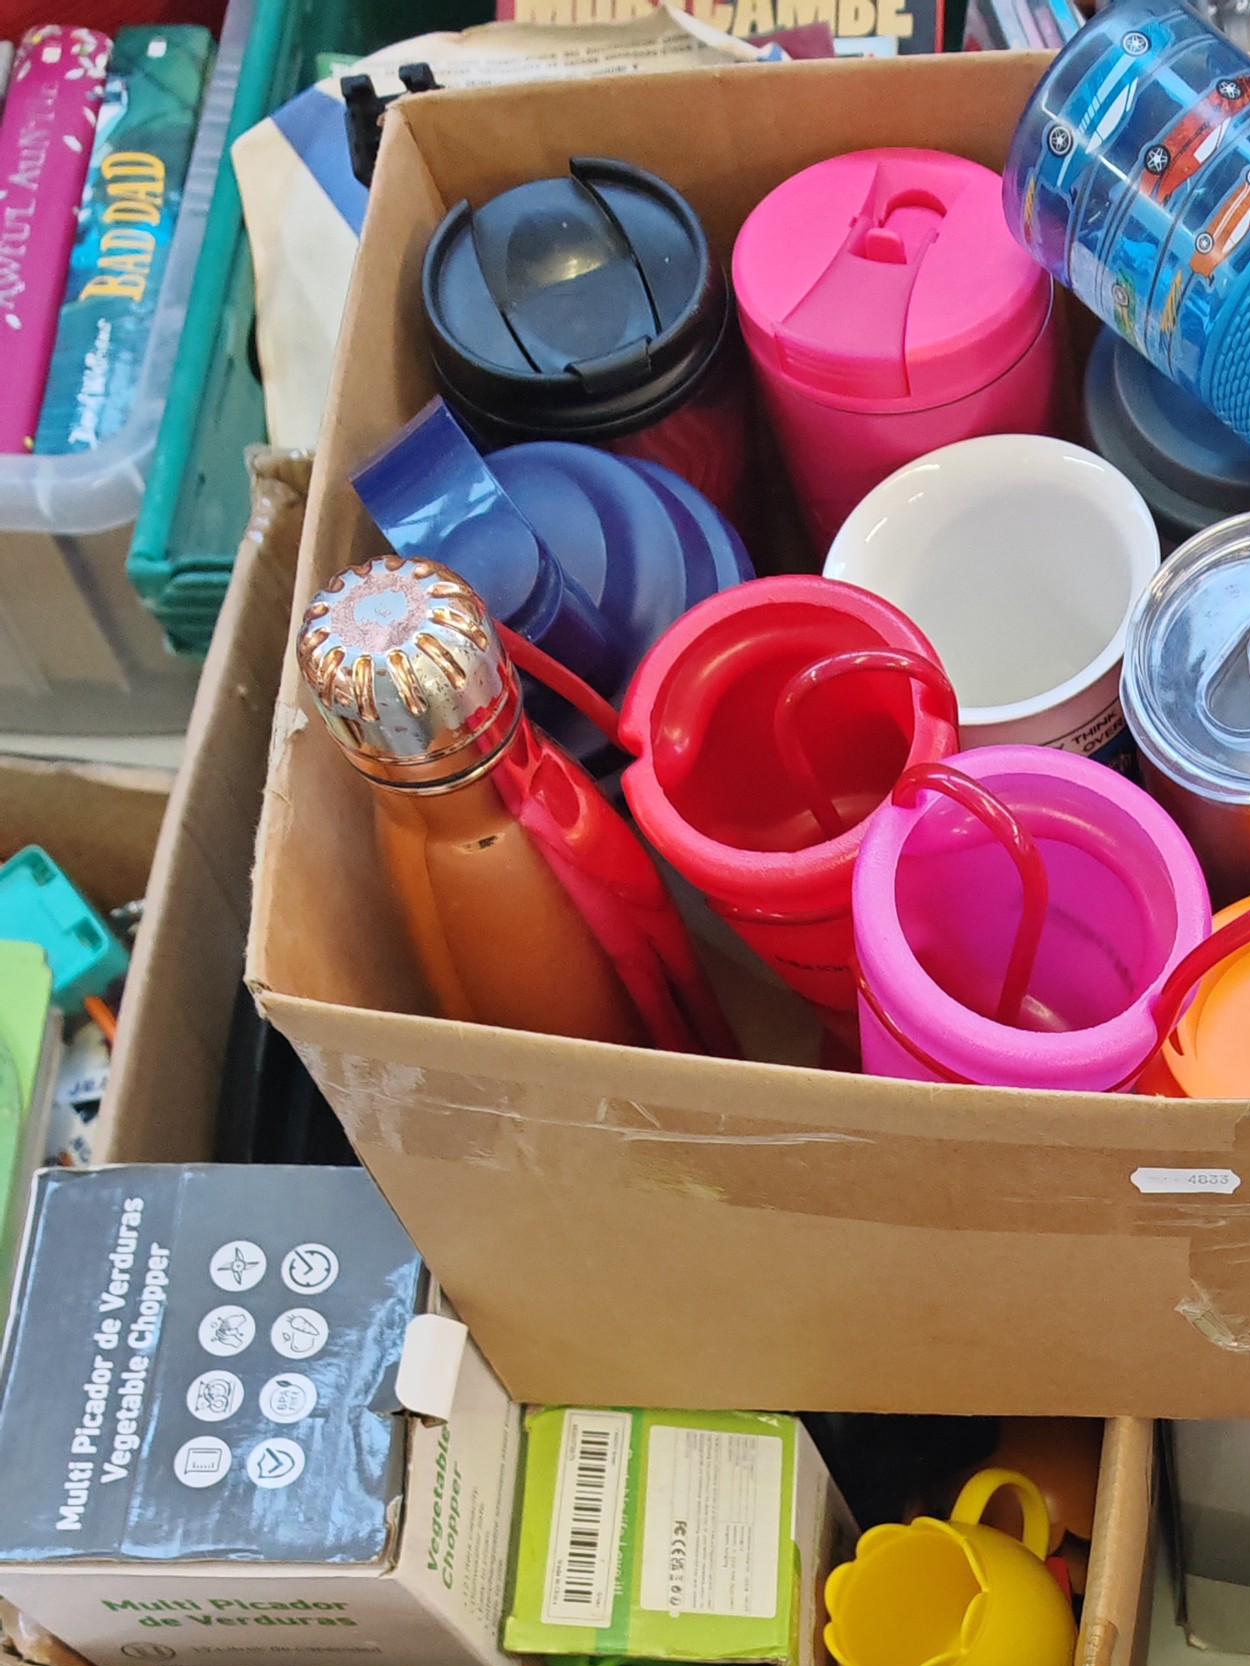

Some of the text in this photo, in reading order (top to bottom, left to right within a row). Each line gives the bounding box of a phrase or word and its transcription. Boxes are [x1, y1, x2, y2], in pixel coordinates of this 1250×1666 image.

[515, 0, 914, 38] CAMBE
[80, 152, 166, 301] BAD DAD
[1071, 709, 1117, 744] THINK
[1083, 718, 1123, 752] OVER
[56, 1197, 144, 1530] Multi Picador de Verduras
[101, 1242, 170, 1484] Vegetable Chopper
[427, 1424, 450, 1570] Vegetable
[442, 1460, 462, 1590] Chopper
[101, 1599, 349, 1611] Multi Picador
[138, 1614, 358, 1627] de Verduras
